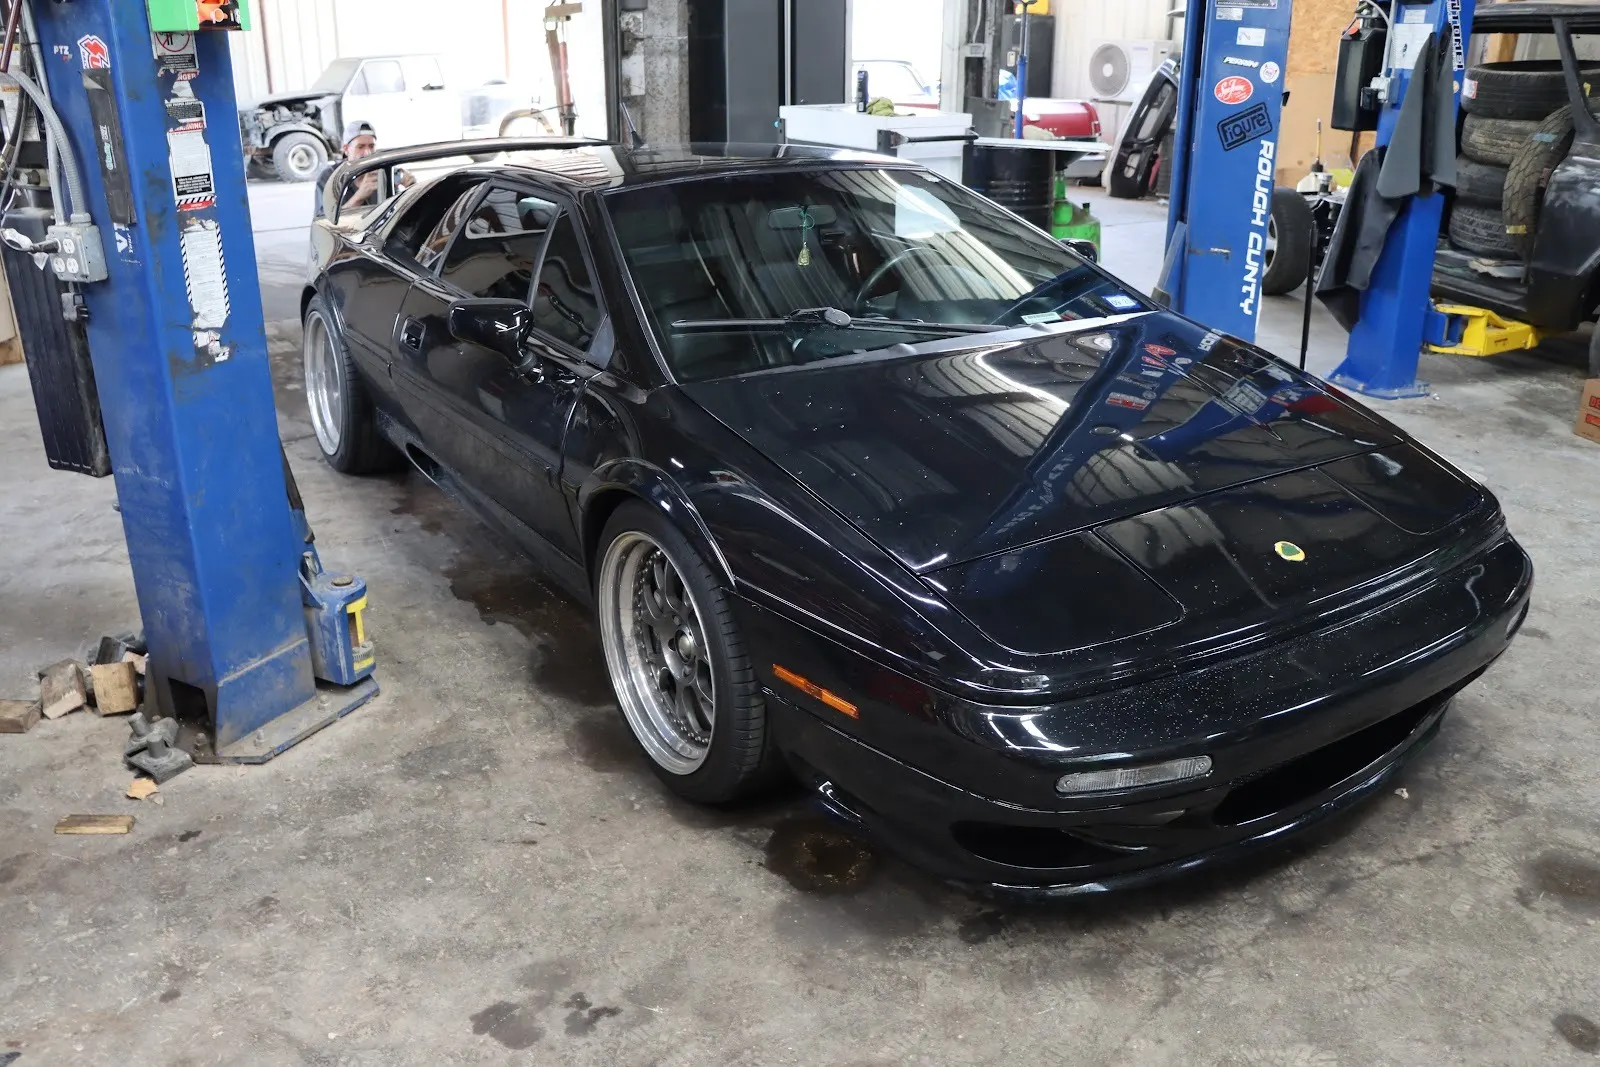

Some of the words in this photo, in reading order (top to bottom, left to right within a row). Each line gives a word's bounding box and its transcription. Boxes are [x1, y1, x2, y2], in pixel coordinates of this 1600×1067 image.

[53, 45, 69, 55] PTZ
[1250, 139, 1275, 227] ROUGH
[1239, 231, 1263, 316] CUNTY
